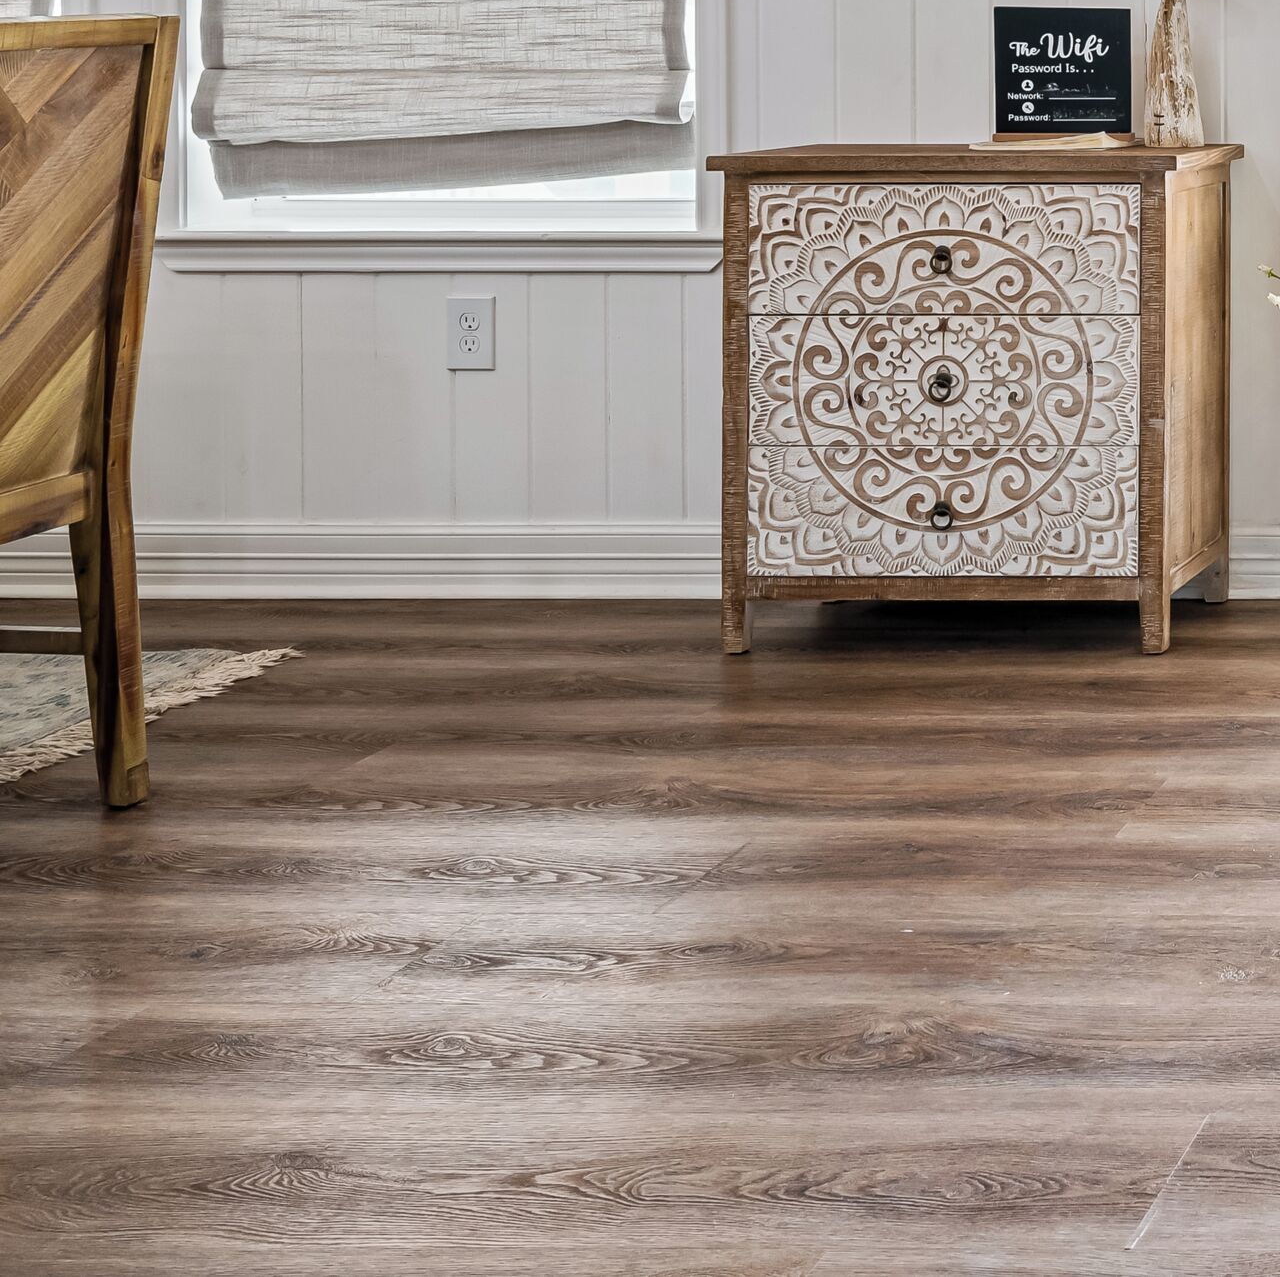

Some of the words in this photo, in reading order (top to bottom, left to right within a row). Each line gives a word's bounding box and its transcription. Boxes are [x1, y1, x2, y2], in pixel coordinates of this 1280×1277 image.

[1009, 41, 1040, 57] The
[1040, 32, 1109, 63] Wifi
[1011, 63, 1062, 73] Password
[1007, 92, 1044, 100] Network:
[1008, 114, 1051, 122] Password:
